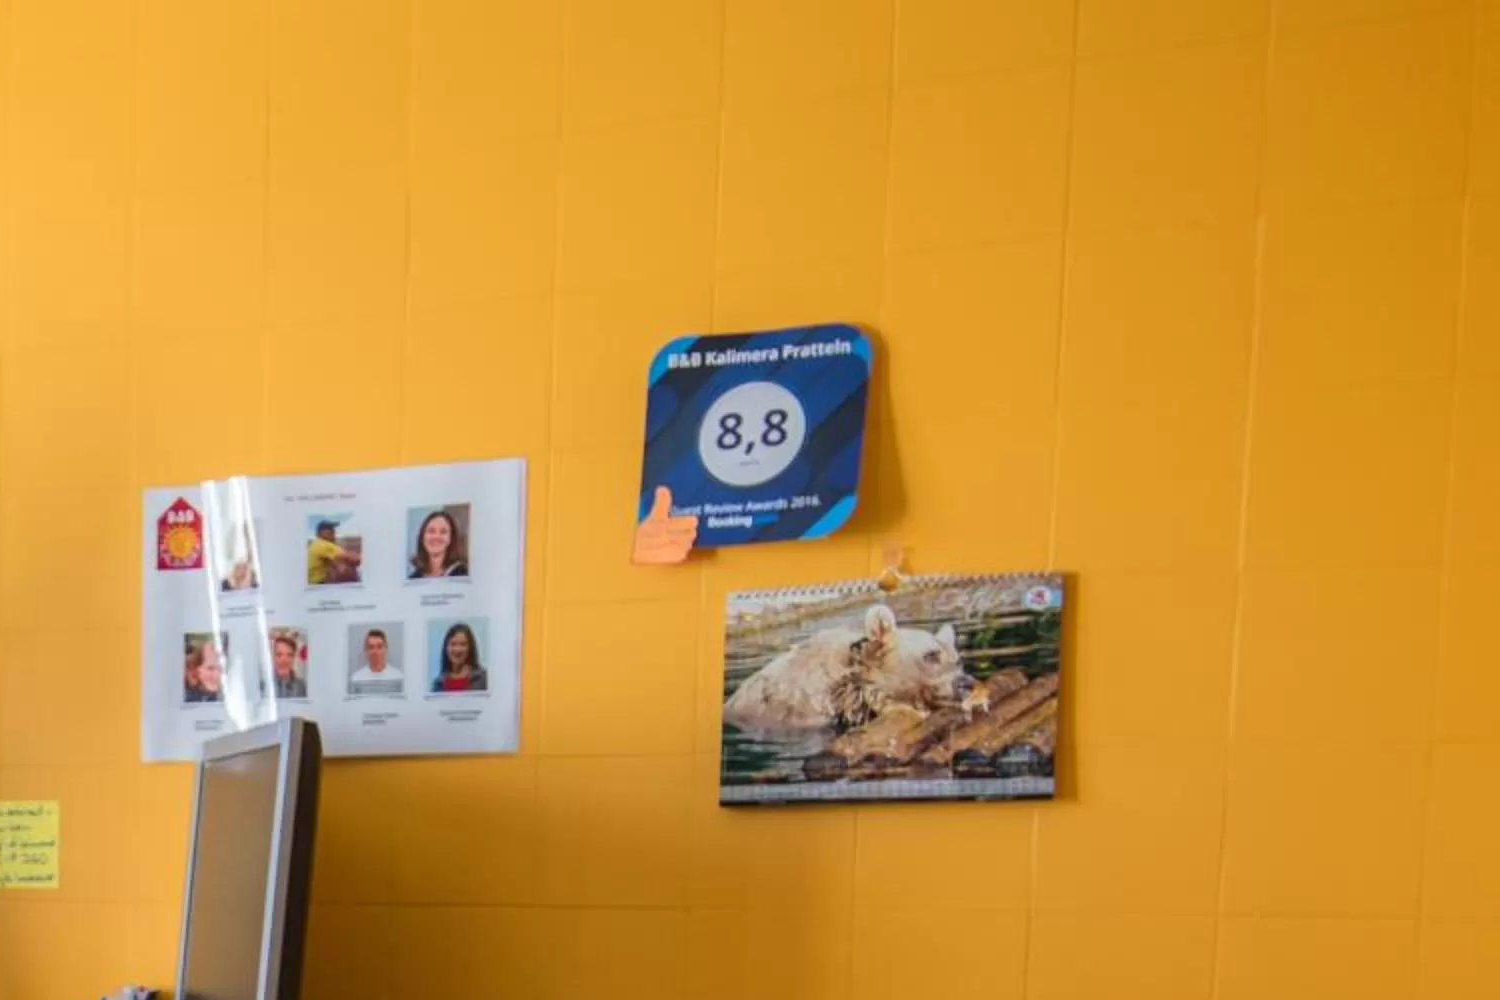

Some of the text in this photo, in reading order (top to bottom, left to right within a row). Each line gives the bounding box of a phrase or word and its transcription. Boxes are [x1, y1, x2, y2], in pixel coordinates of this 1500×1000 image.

[706, 346, 779, 367] Kalimera
[783, 339, 852, 361] Pratteln
[715, 408, 789, 455] 8,8
